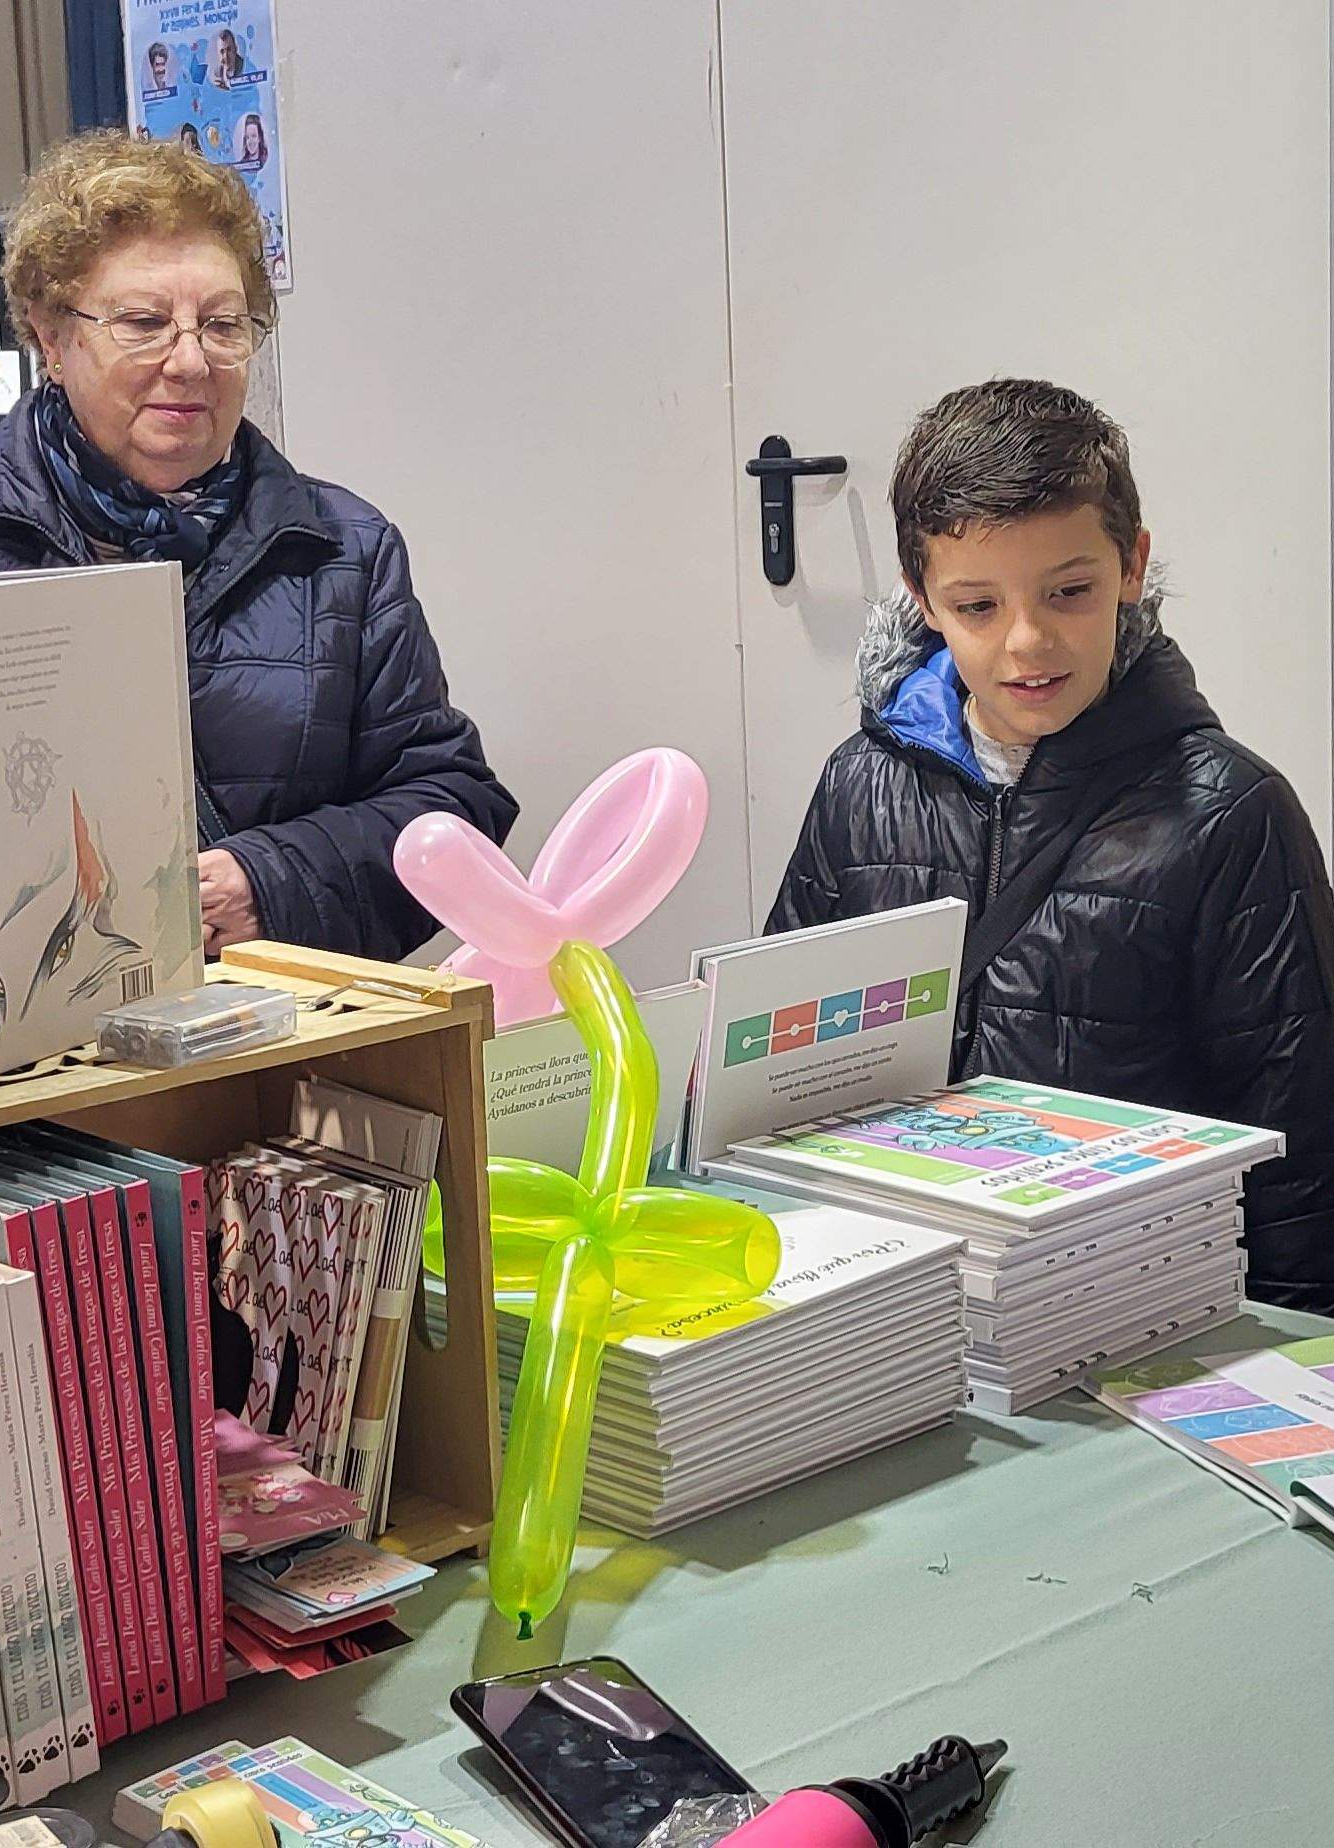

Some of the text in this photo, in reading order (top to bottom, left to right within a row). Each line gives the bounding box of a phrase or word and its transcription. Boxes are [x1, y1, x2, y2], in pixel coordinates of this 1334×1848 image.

[490, 1071, 502, 1082] La
[505, 1062, 546, 1081] princesa
[549, 1056, 571, 1068] llora
[491, 1084, 517, 1103] ¿Qué
[519, 1075, 550, 1093] tendrá
[553, 1074, 561, 1085] la
[487, 1100, 537, 1120] Ayúdanos
[538, 1098, 545, 1107] a
[979, 1123, 1189, 1187] Con los cinco sentidos
[145, 1281, 161, 1329] Becana
[191, 1270, 208, 1316] Becana
[27, 1342, 39, 1384] Heredia
[74, 1227, 118, 1493] Mis Princesas de las bragas de fresa
[100, 1218, 143, 1482] Mis Princesas de las bragas de fresa
[148, 1335, 167, 1378] Carlos
[194, 1323, 210, 1366] Carlos
[45, 1236, 90, 1503] Mis Princesas de las bragas de fresa
[196, 1369, 212, 1402] Soler
[3, 1393, 13, 1422] Pérez
[33, 1384, 43, 1413] Pérez
[153, 1380, 171, 1414] Soler
[12, 1460, 23, 1496] Guirao
[42, 1450, 53, 1486] Guirao
[17, 1496, 27, 1527] David
[46, 1485, 57, 1517] David
[133, 1498, 148, 1531] Soler
[82, 1517, 97, 1551] Soler
[109, 1507, 124, 1539] Soler
[113, 1541, 129, 1584] Carlos
[137, 1532, 153, 1574] Carlos
[157, 1428, 199, 1683] Mis Princesas de las bragas de fresa
[197, 1416, 224, 1673] Mis Princesas de las bragas de fresa
[86, 1552, 102, 1595] Carlos
[93, 1601, 109, 1648] Becana
[120, 1590, 136, 1637] Becana
[143, 1581, 159, 1627] Becana
